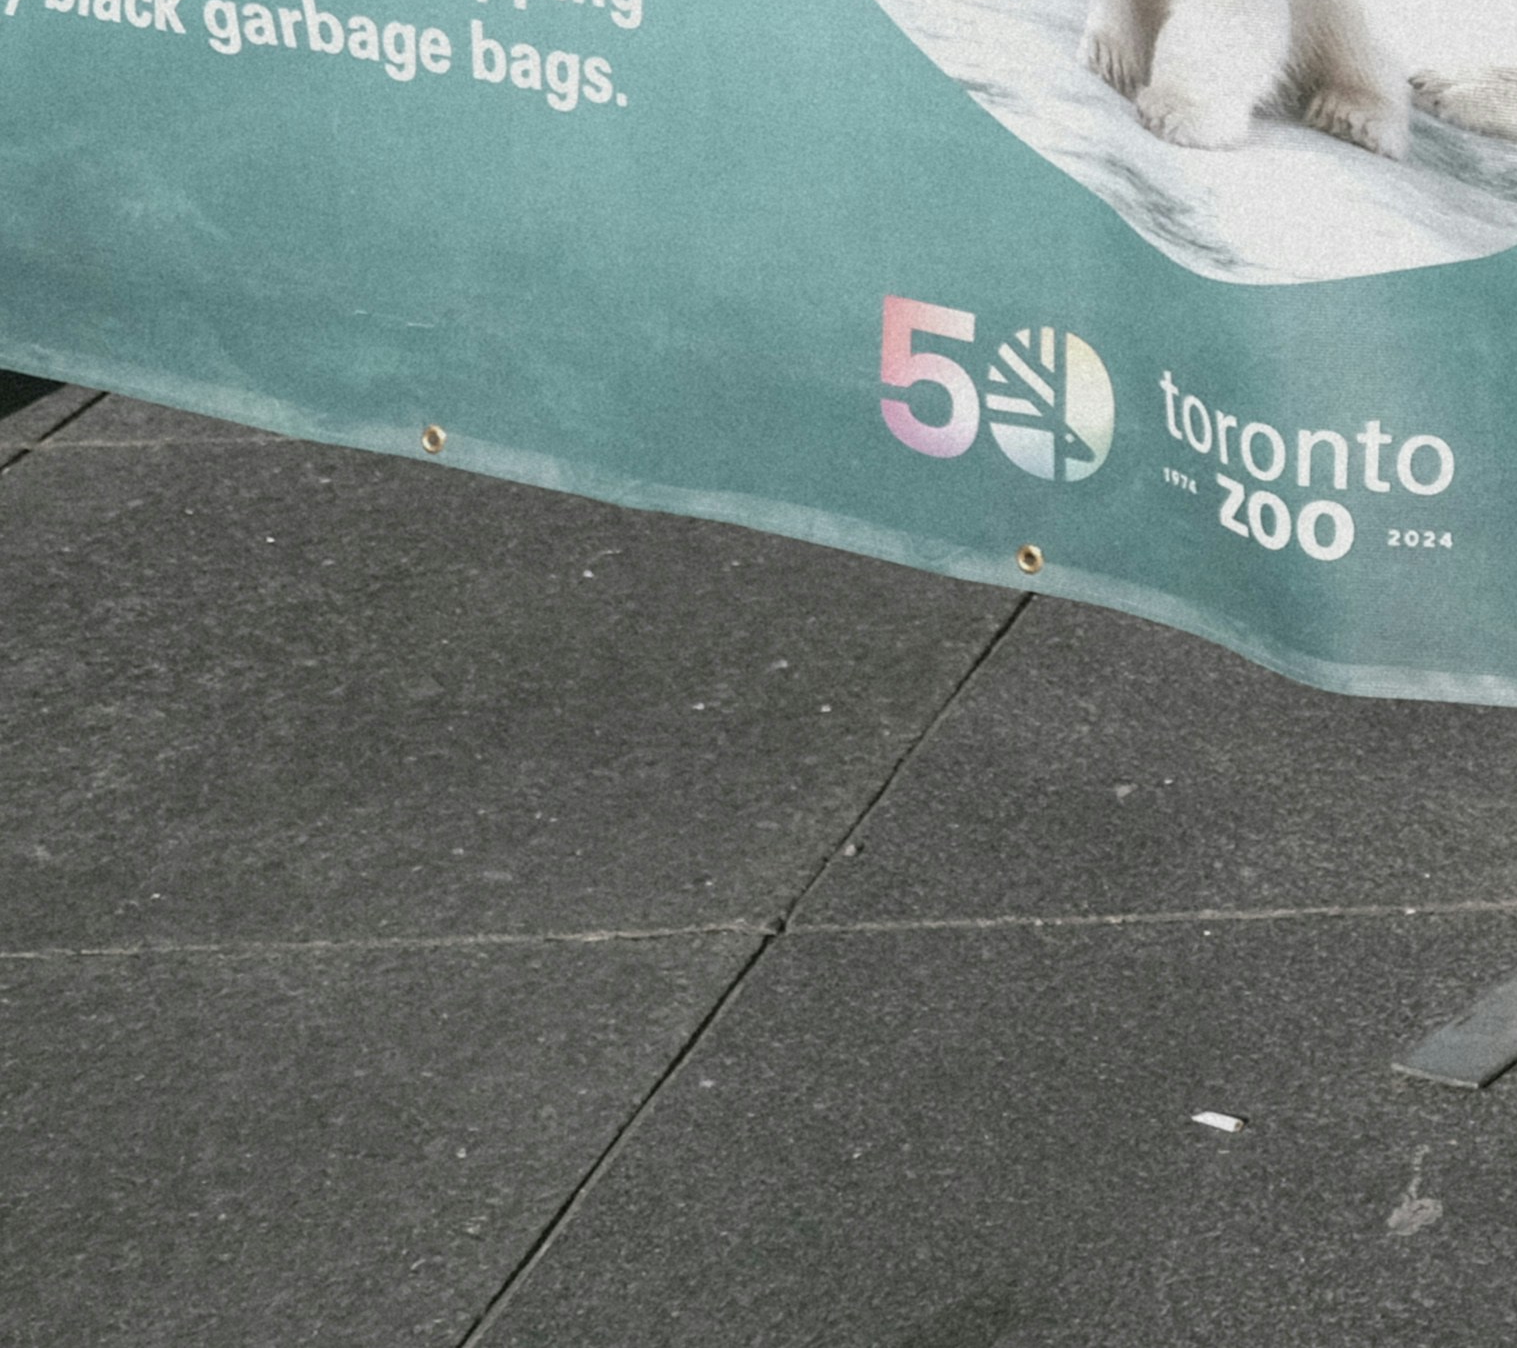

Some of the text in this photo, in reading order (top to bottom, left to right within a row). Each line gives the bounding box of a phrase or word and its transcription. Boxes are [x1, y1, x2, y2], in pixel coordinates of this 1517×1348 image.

[470, 18, 628, 112] bags.
[1158, 368, 1457, 497] toronto
[1387, 527, 1455, 550] 2024
